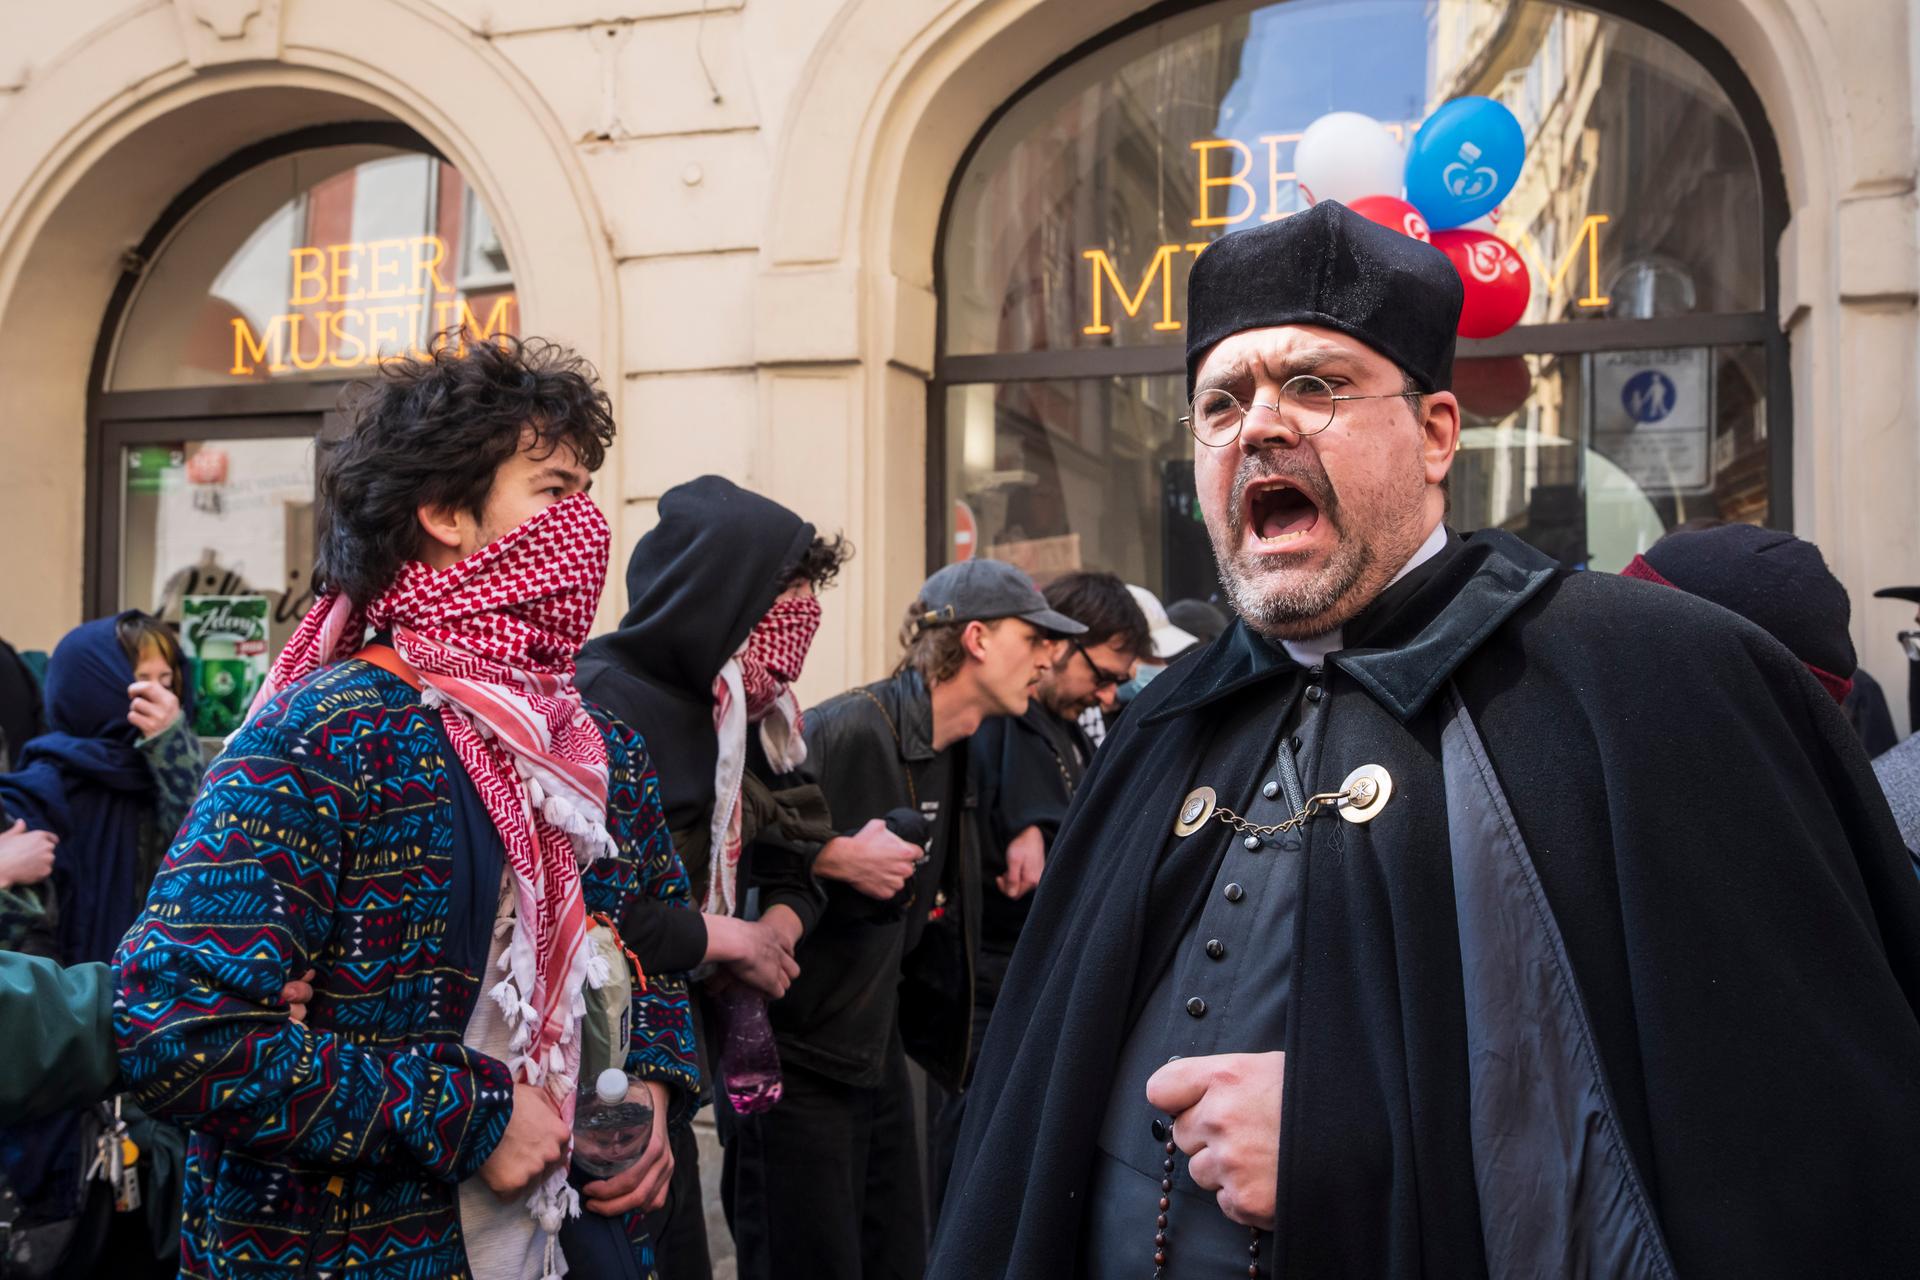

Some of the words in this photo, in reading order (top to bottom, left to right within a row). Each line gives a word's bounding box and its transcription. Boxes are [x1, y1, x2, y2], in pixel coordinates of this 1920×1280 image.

[1190, 122, 1421, 227] BE
[288, 235, 456, 306] BEER
[229, 296, 514, 375] MUSEUM
